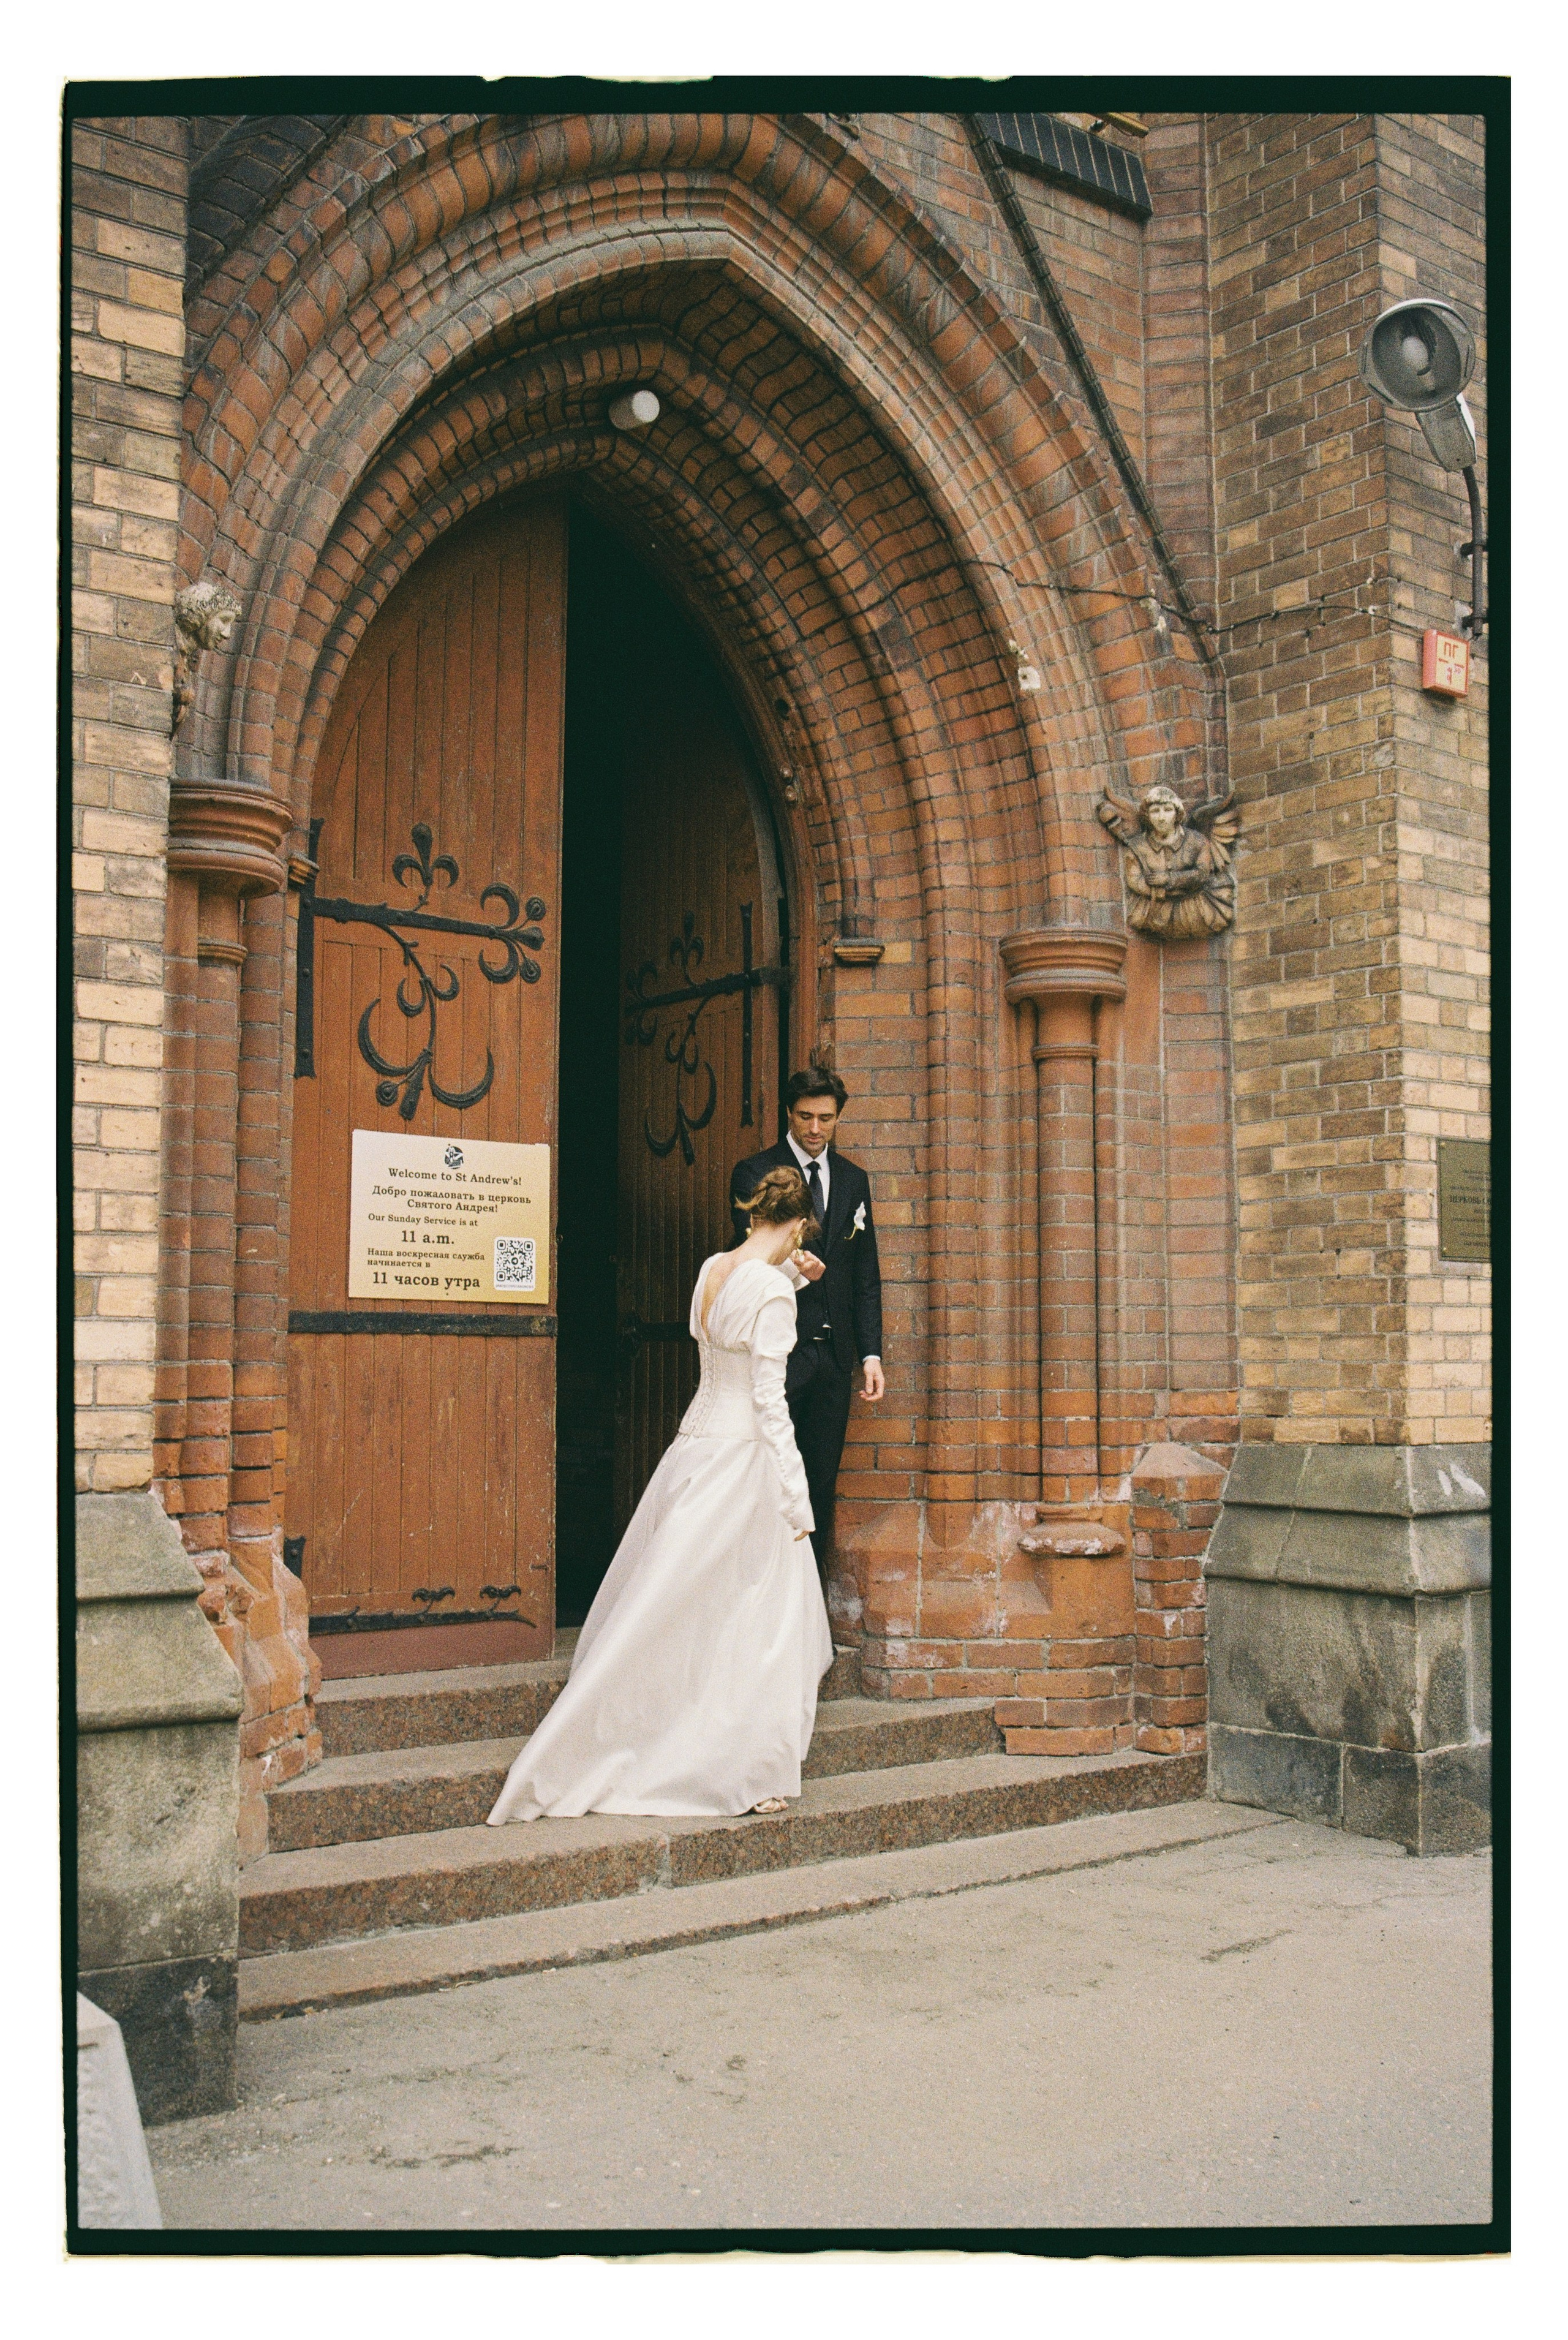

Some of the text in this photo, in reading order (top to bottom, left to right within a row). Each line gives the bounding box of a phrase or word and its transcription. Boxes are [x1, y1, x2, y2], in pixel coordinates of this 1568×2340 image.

[388, 1168, 437, 1180] Welcome
[441, 1172, 452, 1181] to
[456, 1172, 467, 1182] St
[372, 1186, 407, 1197] Добро
[410, 1190, 475, 1201] пожаловать
[488, 1195, 532, 1204] церковь
[407, 1199, 499, 1213] Святого Андрея!
[368, 1213, 385, 1222] Our
[388, 1215, 421, 1225] Sunday
[424, 1217, 456, 1226] Service
[401, 1230, 454, 1245] 11 a.m.
[368, 1248, 486, 1261] Наша воскресная служба
[367, 1260, 423, 1269] начинается
[372, 1272, 481, 1291] 11 часов утра
